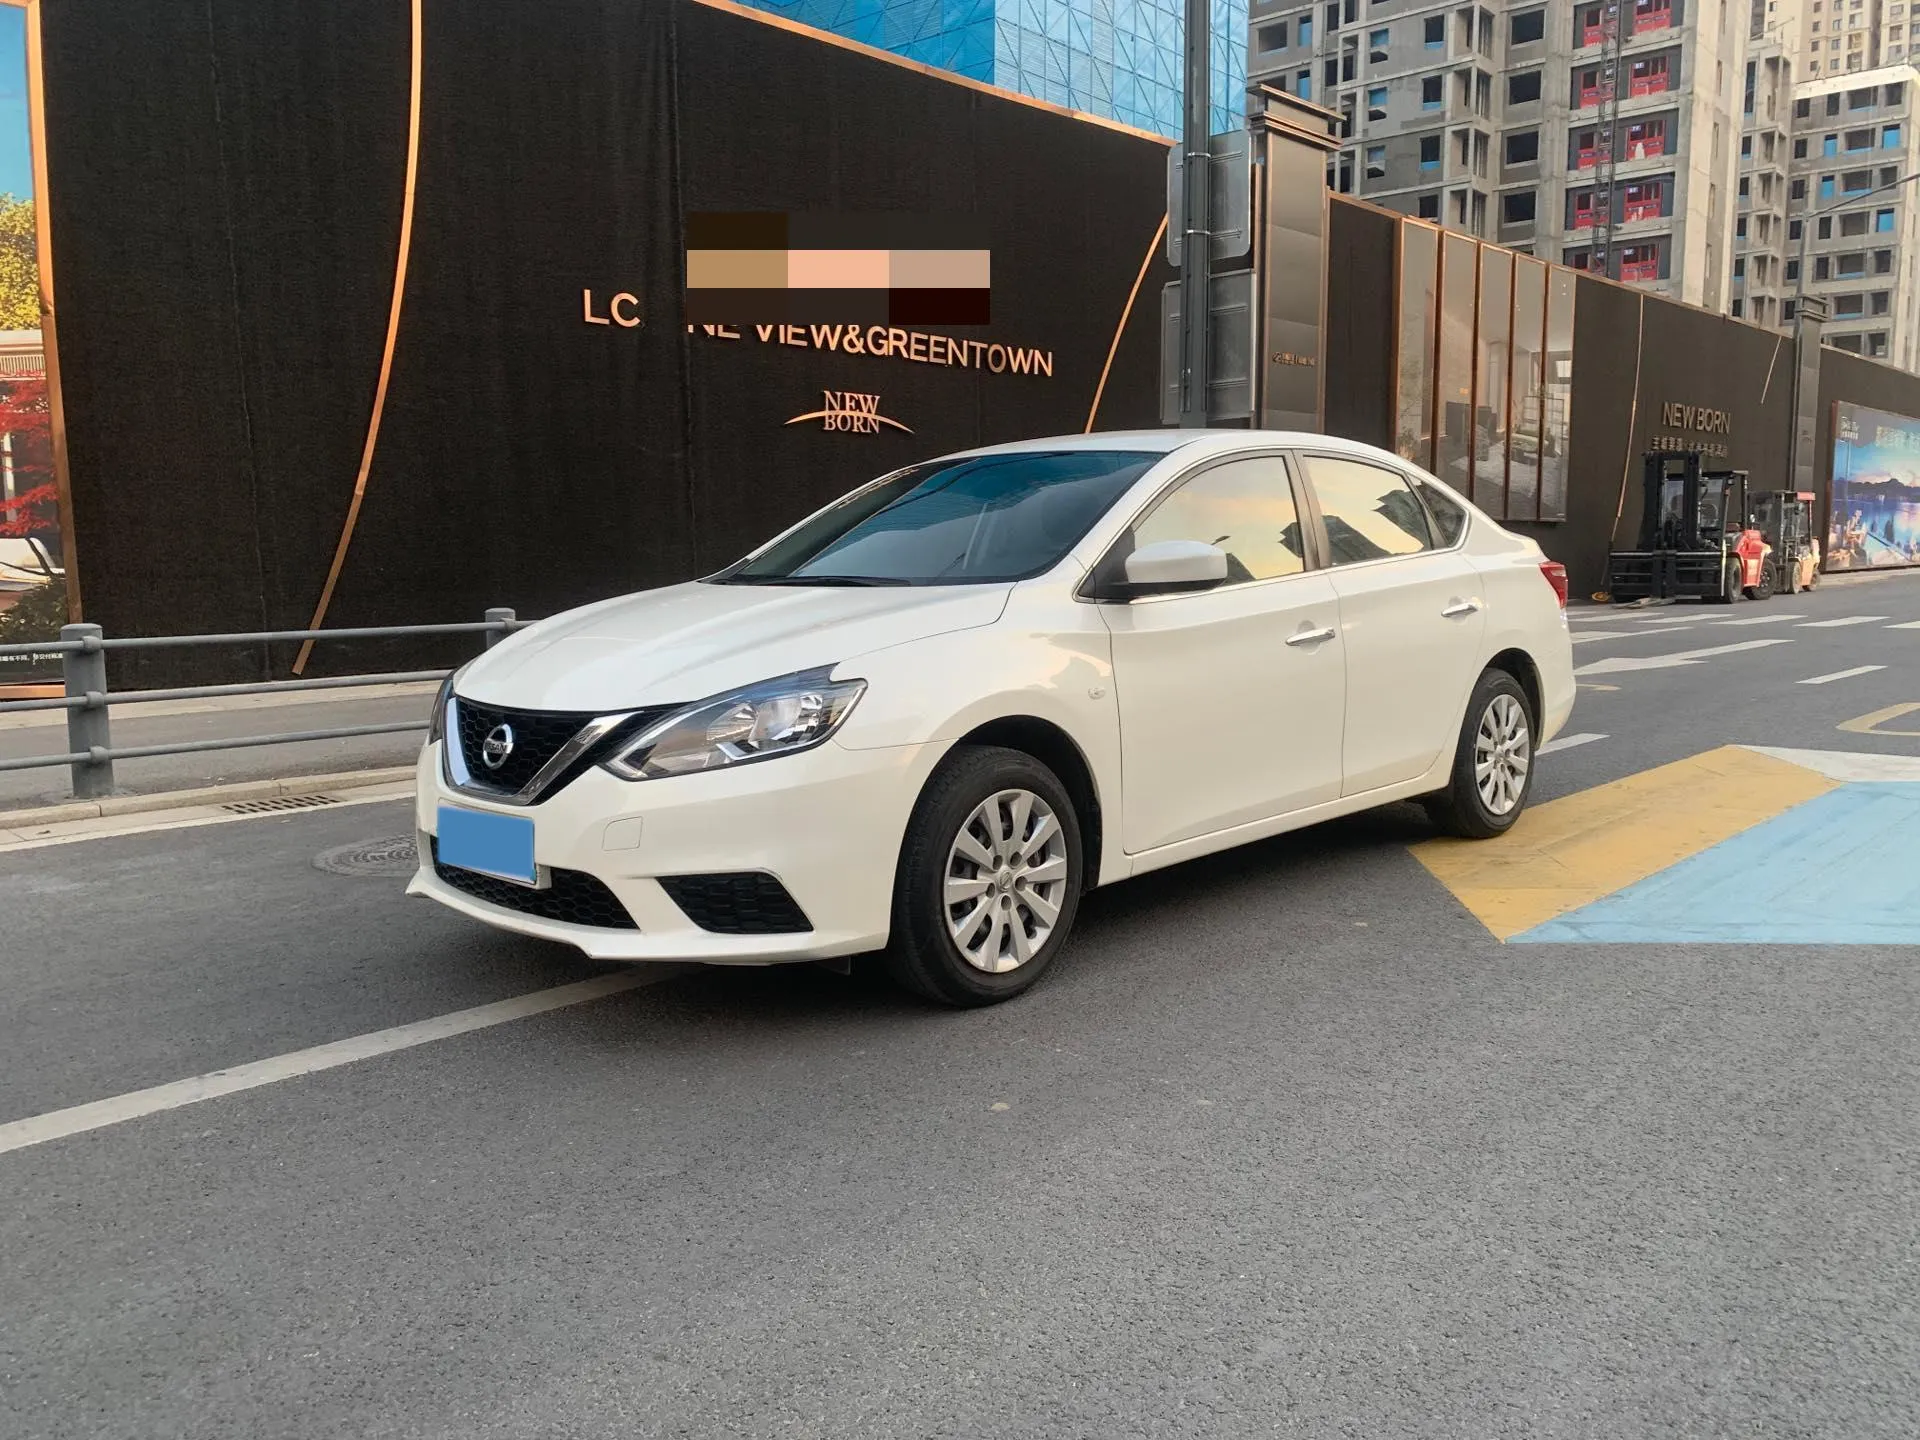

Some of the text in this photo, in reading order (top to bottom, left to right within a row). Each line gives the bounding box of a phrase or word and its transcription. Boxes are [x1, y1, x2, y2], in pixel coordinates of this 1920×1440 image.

[584, 289, 641, 327] LC
[823, 390, 880, 415] NEW
[823, 413, 880, 434] BORN
[1662, 401, 1731, 434] NEW BORN
